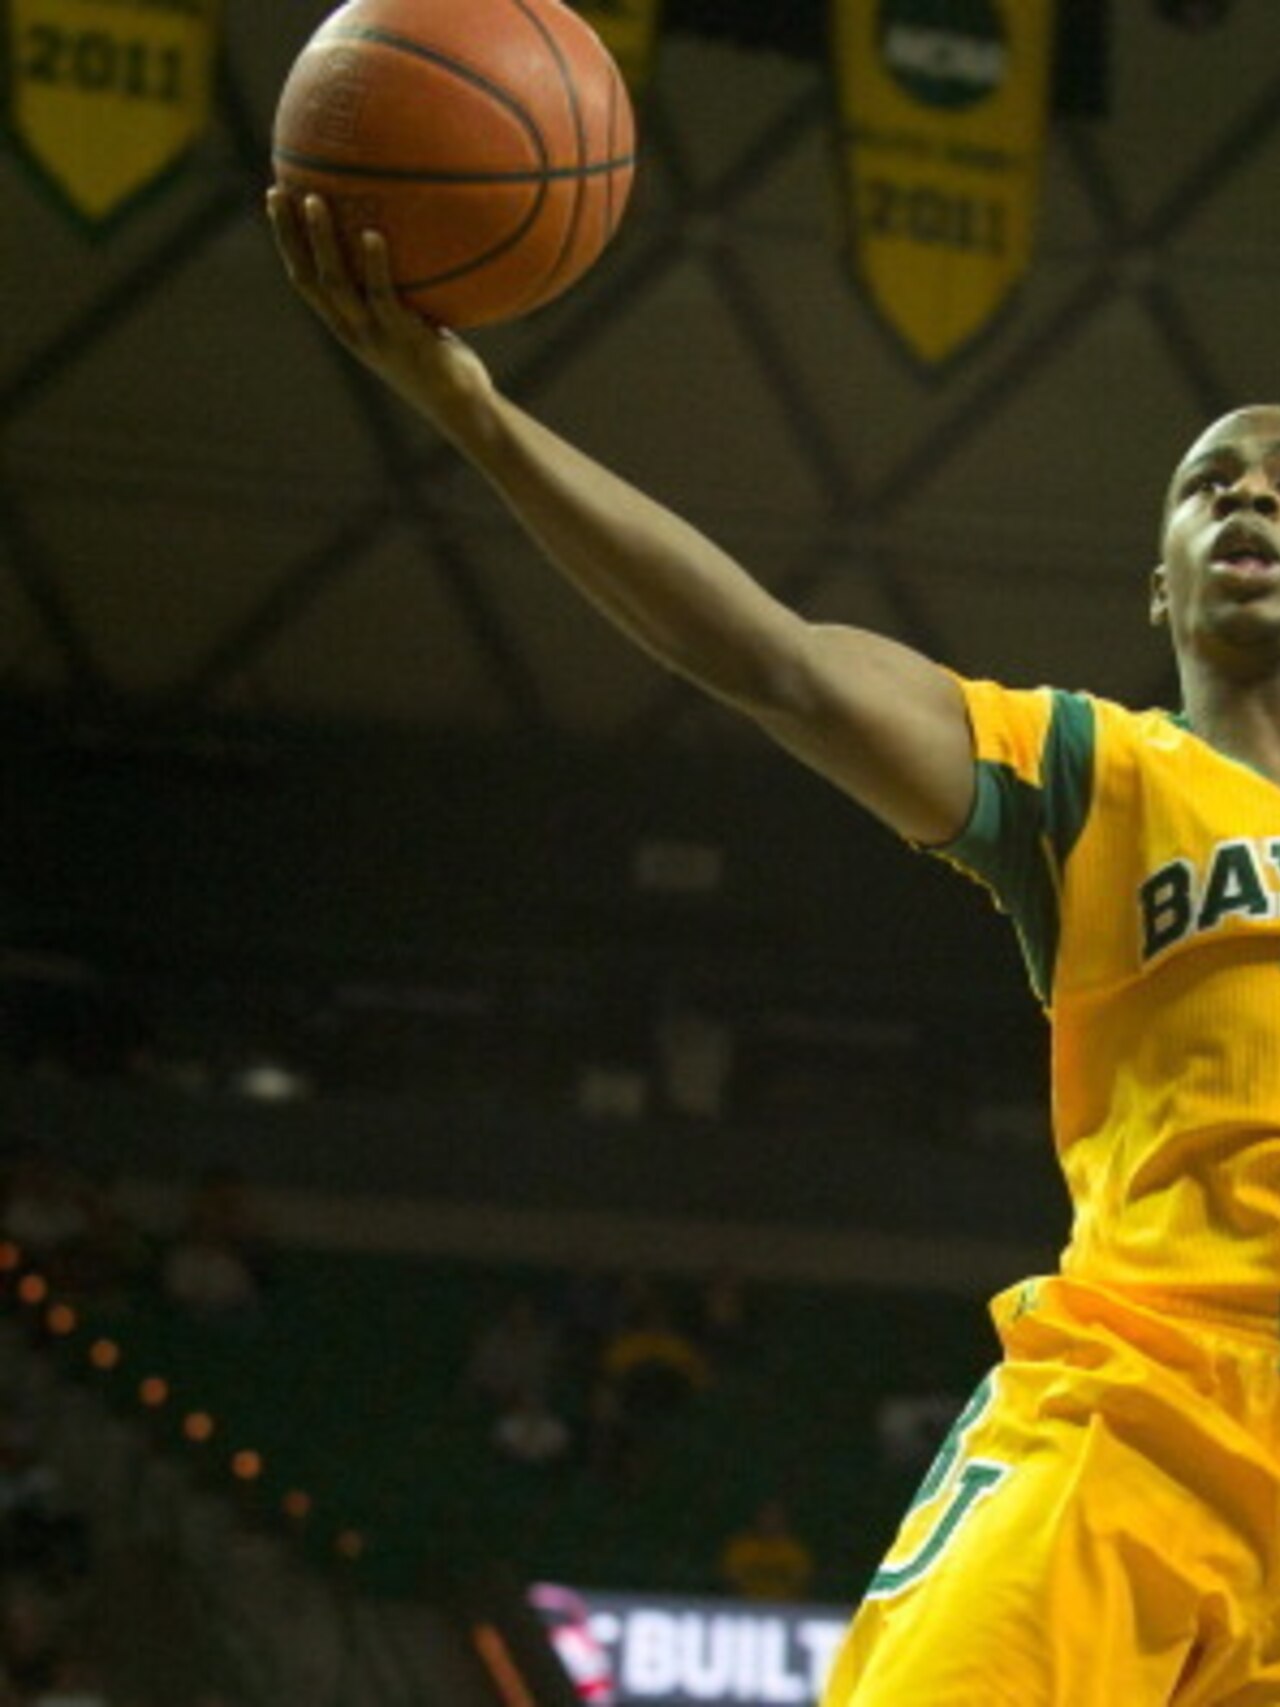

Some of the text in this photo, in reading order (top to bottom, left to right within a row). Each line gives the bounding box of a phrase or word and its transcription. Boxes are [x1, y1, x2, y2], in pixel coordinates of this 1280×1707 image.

[26, 23, 183, 101] 2011
[866, 176, 1008, 256] 2011
[622, 1608, 850, 1702] BUILT
